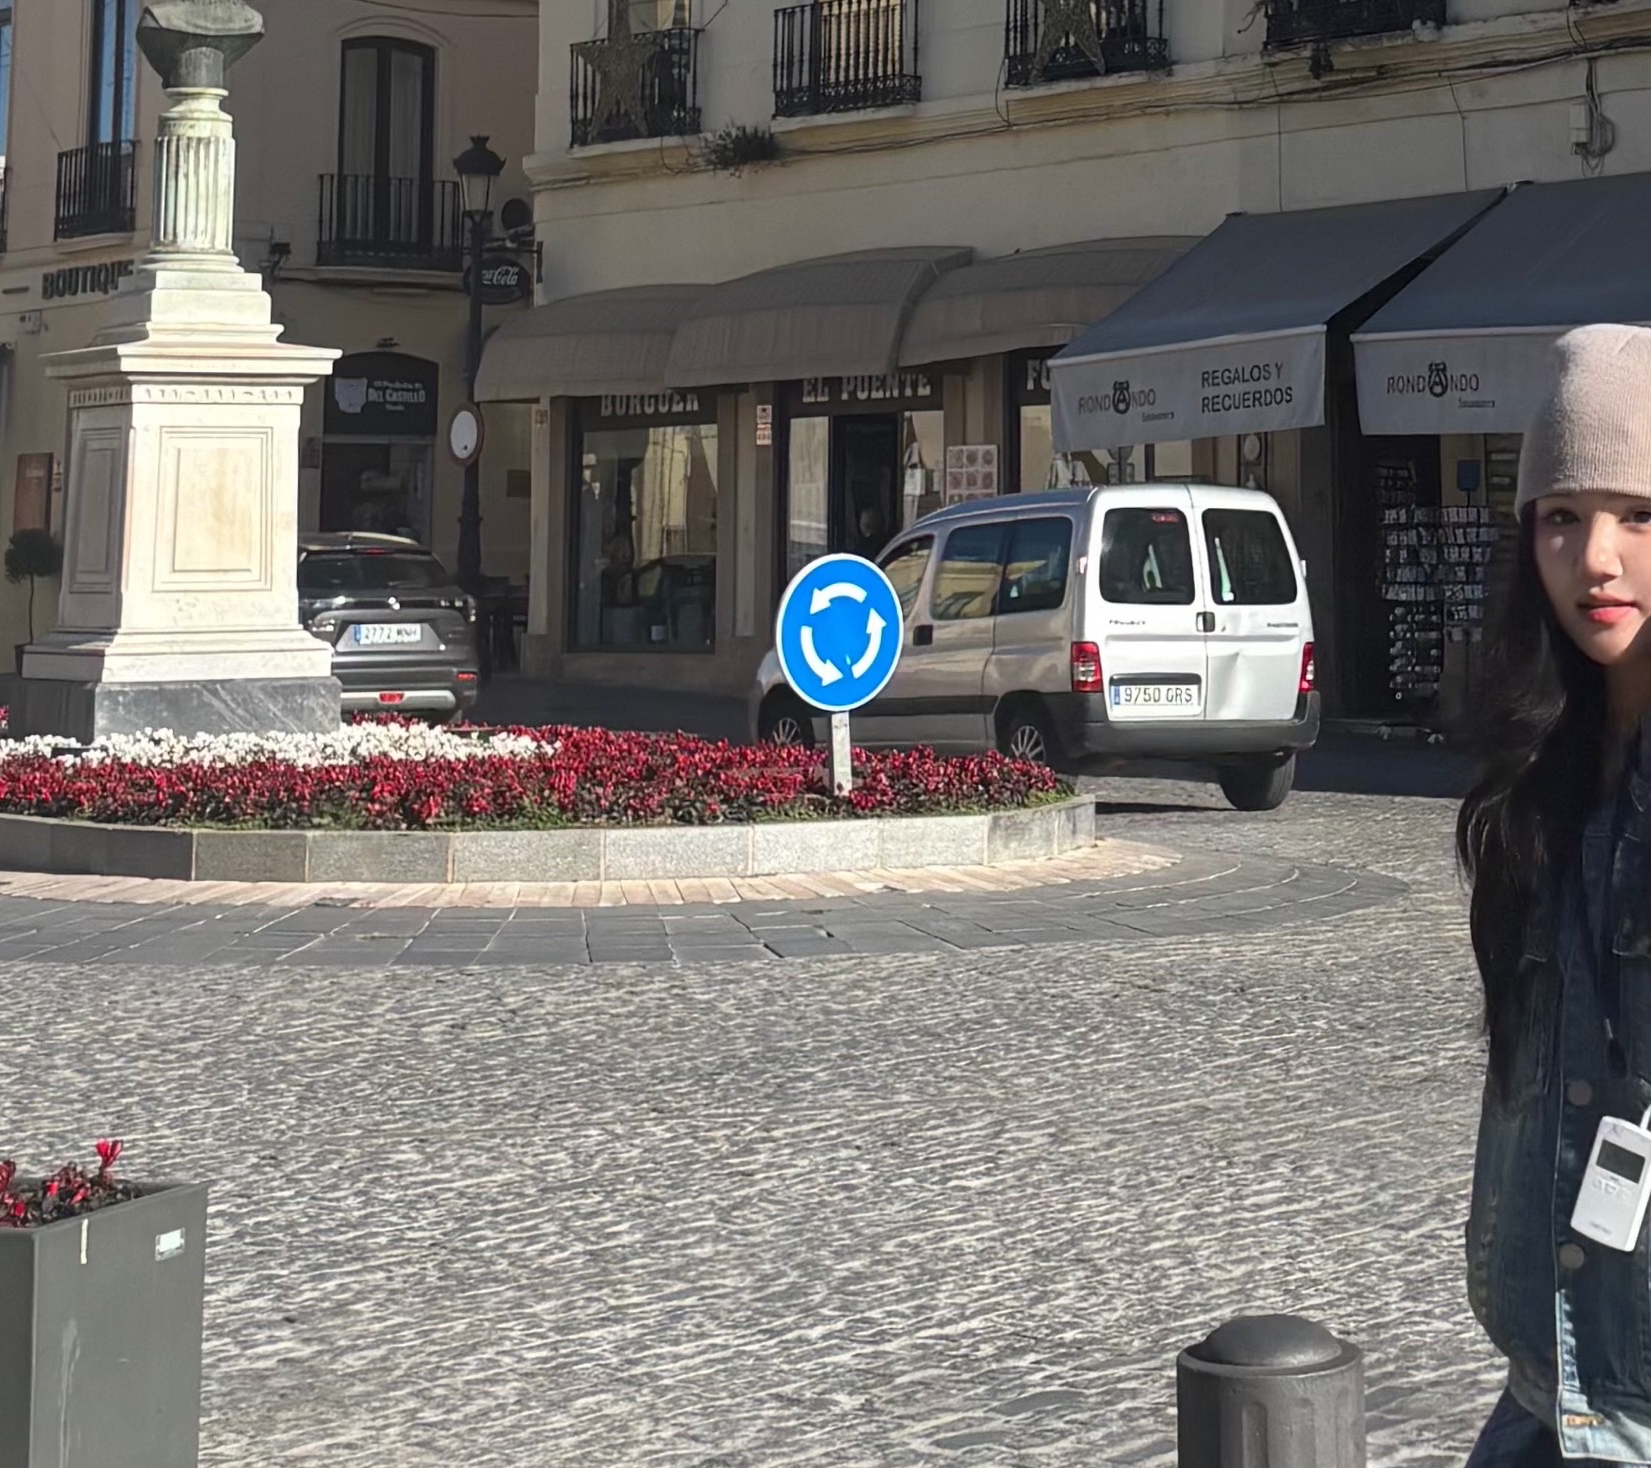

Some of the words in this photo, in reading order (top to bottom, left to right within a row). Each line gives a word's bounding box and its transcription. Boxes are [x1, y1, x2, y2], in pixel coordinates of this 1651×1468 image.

[802, 376, 829, 402] EL
[841, 373, 931, 400] PUENTE
[1201, 363, 1272, 389] REGALOS
[1274, 362, 1284, 381] Y
[601, 393, 699, 416] BURGUER
[1201, 386, 1293, 414] RECUERDOS
[1124, 687, 1161, 704] 9750
